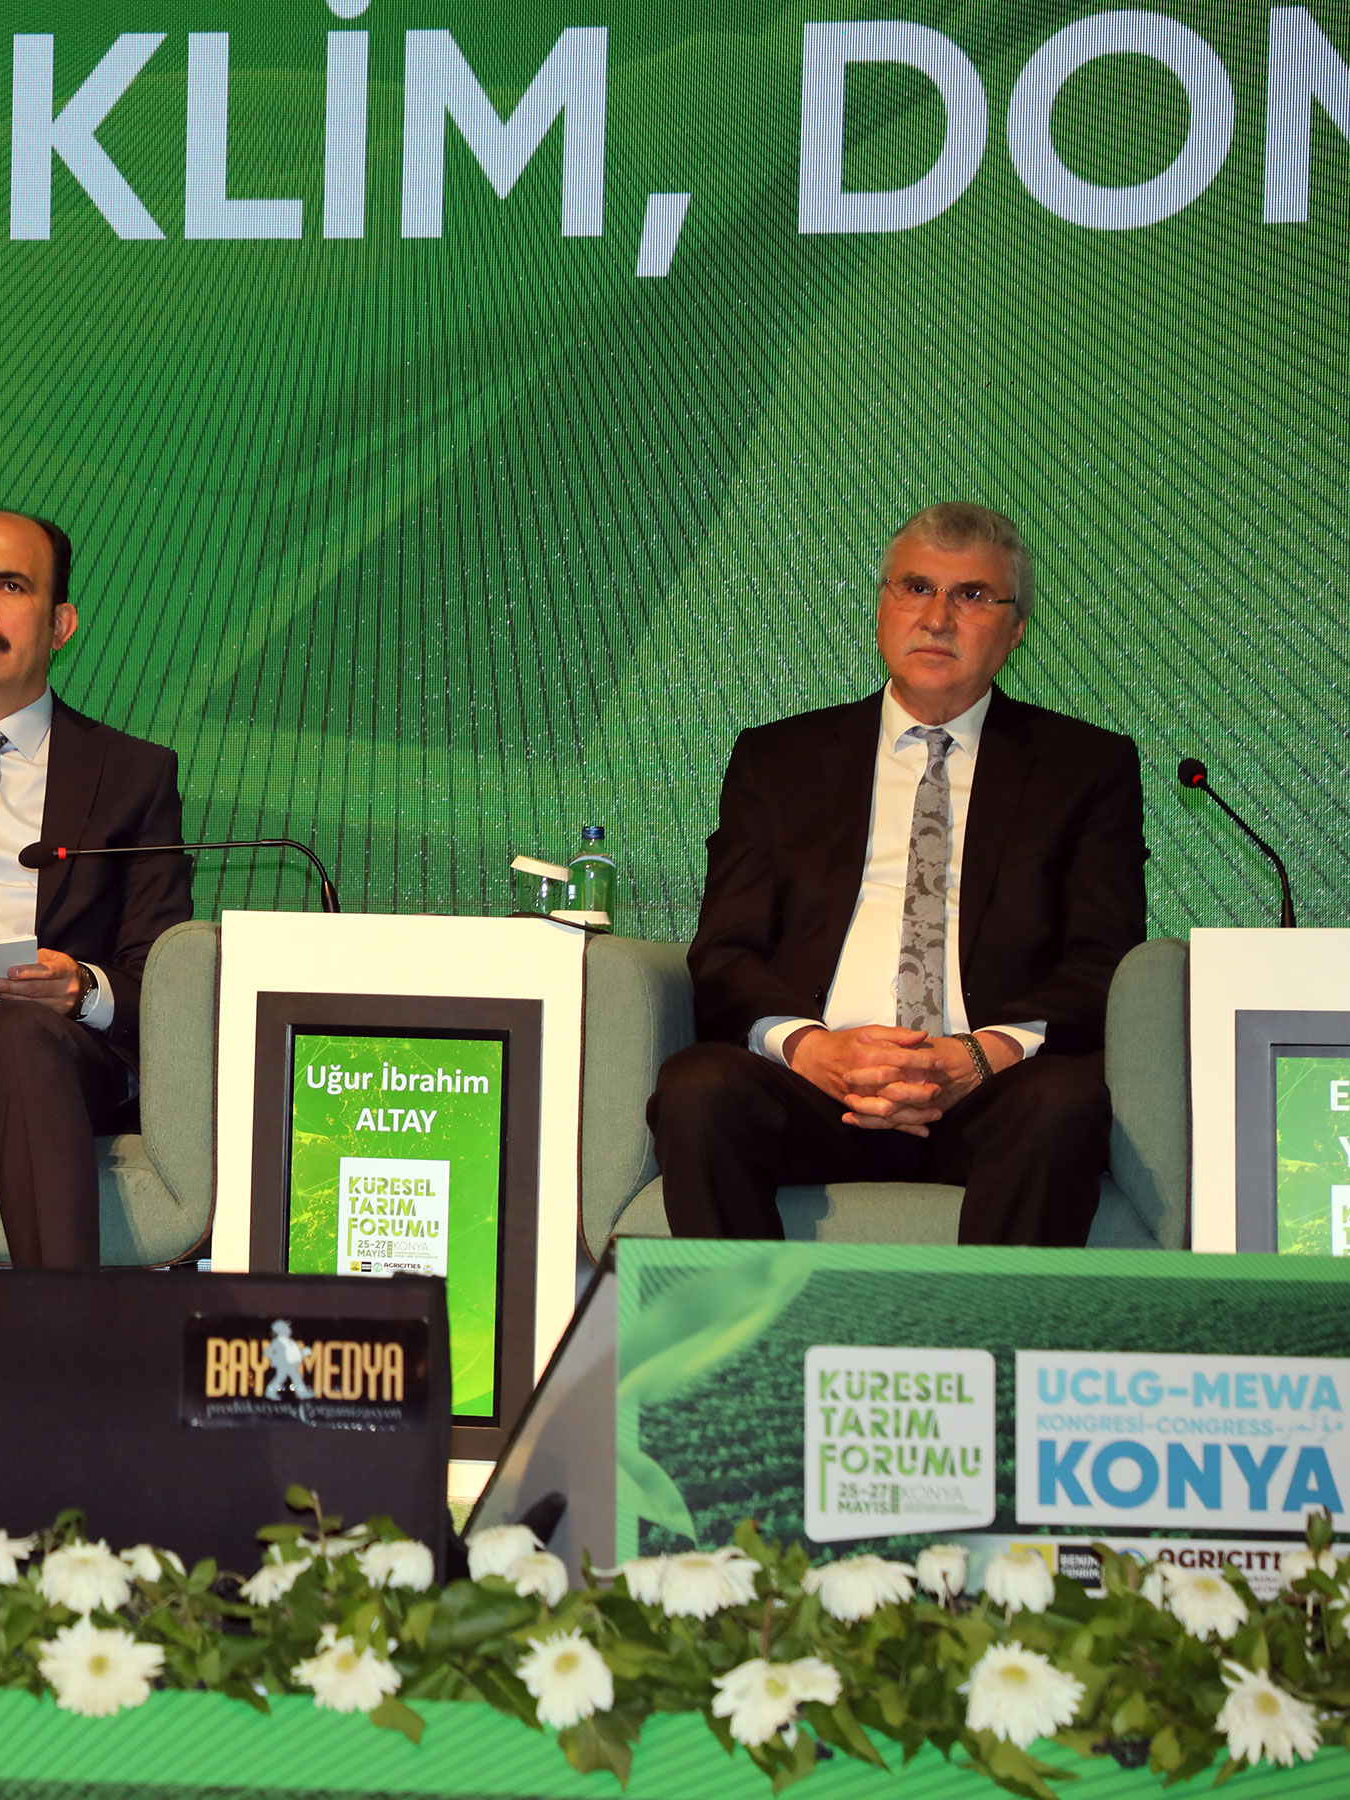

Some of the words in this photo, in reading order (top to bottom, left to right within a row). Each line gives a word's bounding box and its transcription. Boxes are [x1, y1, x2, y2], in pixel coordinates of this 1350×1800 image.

[306, 1064, 374, 1096] Uğur
[381, 1061, 490, 1094] İbrahim
[355, 1107, 438, 1133] ALTAY
[348, 1176, 436, 1197] KÜRESEL
[348, 1197, 416, 1217] TARIM
[357, 1240, 387, 1249] 25-27
[393, 1241, 429, 1251] KONYA
[357, 1249, 387, 1258] MAYIS
[206, 1337, 271, 1398] BAY
[818, 1370, 974, 1404] KÜRESEL
[1036, 1367, 1343, 1412] UCLG-MEWA
[818, 1406, 940, 1439] TARIM
[1038, 1439, 1344, 1514] KONYA
